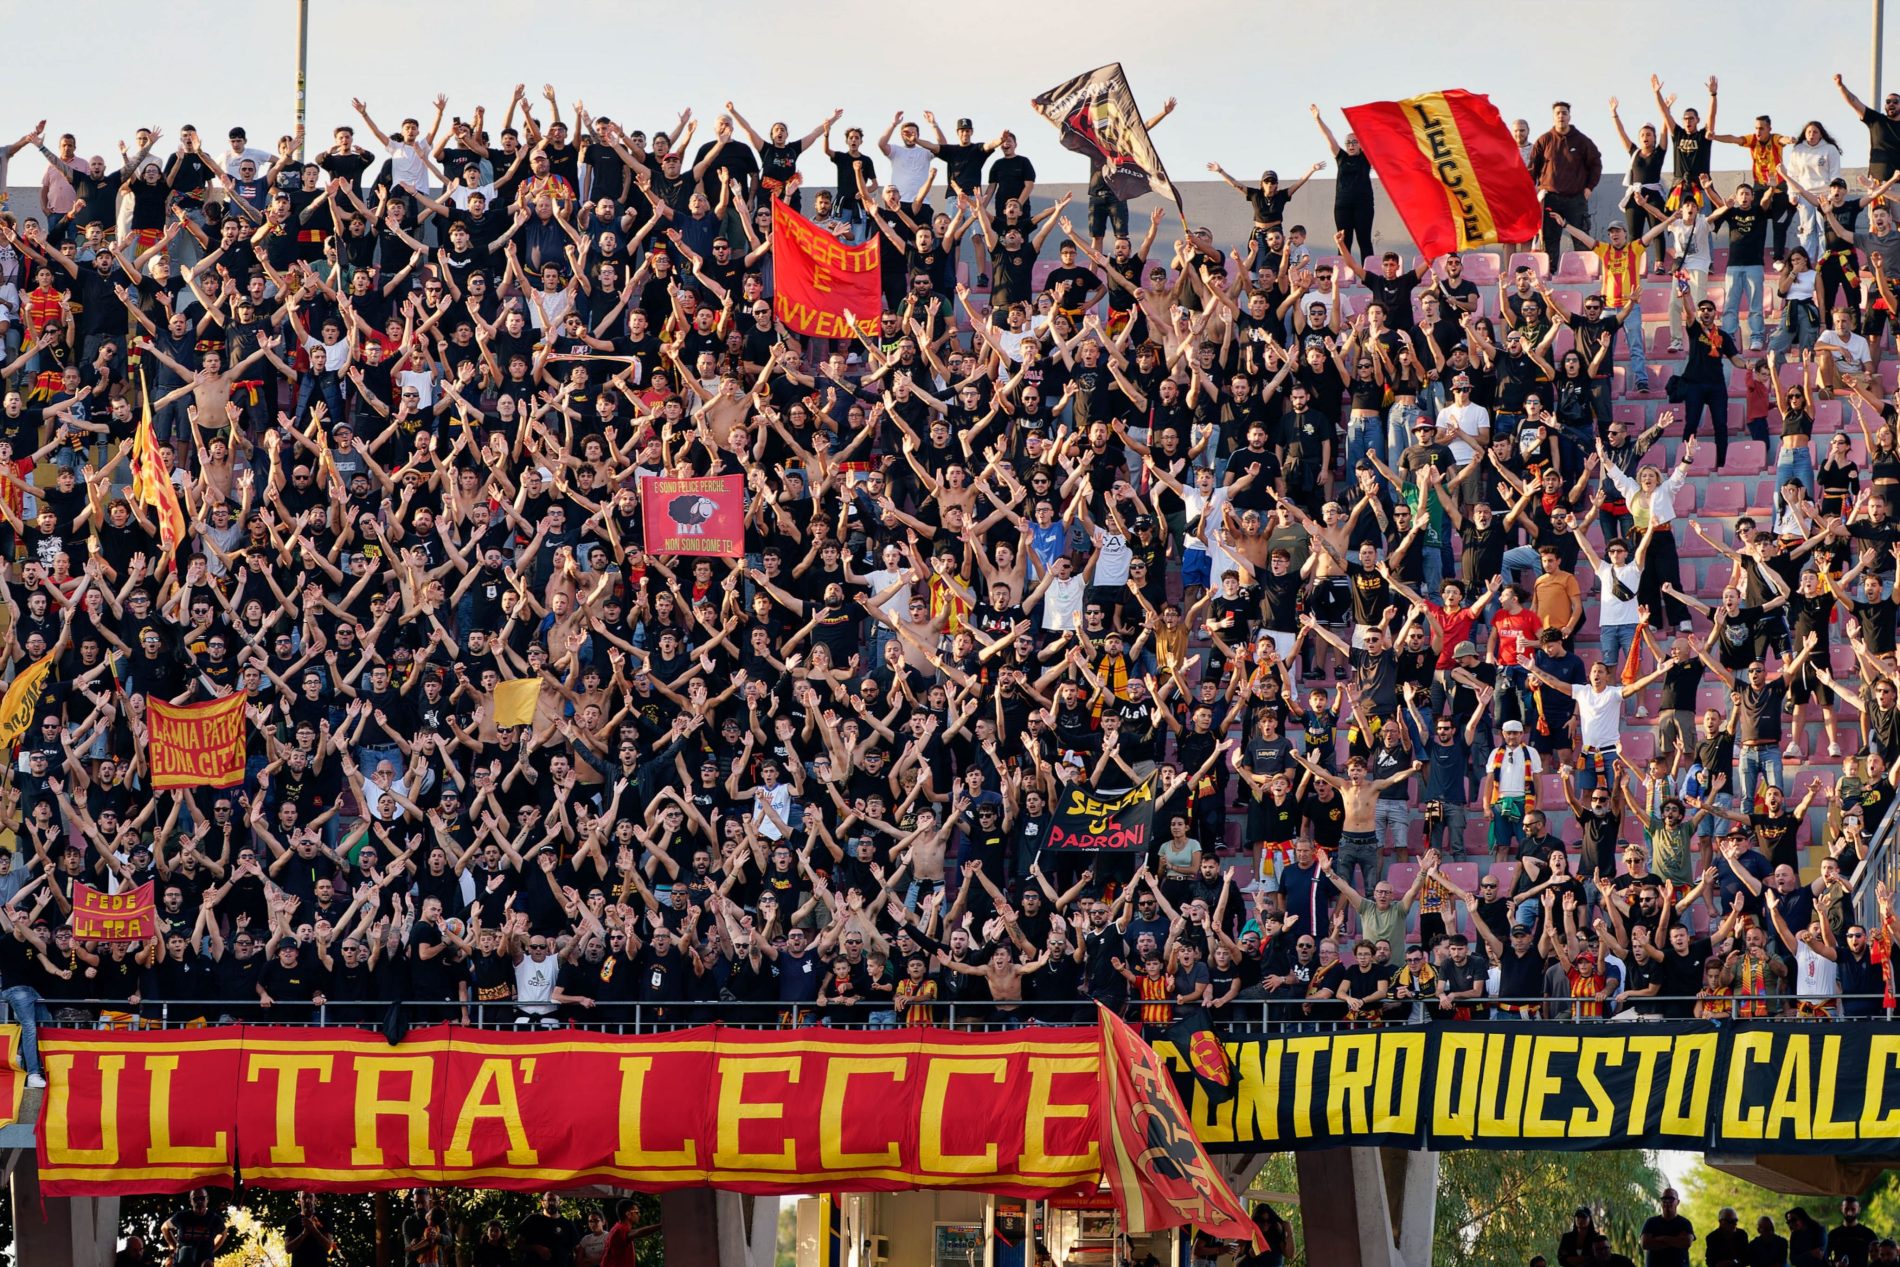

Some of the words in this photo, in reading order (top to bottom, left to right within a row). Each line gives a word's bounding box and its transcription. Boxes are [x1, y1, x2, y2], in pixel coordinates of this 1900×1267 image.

[1413, 104, 1484, 242] LECCE
[776, 206, 879, 273] PASSATO
[813, 265, 831, 293] E
[661, 481, 677, 493] SONO
[679, 481, 699, 493] FELICE
[682, 539, 700, 552] SONO
[702, 539, 721, 553] COME
[1066, 781, 1152, 816] SENZA
[1047, 823, 1144, 849] PADRONI
[85, 892, 136, 910] FEDE
[1433, 1032, 1718, 1141] QUESTO
[1722, 1031, 1900, 1140] CALC
[46, 1054, 537, 1166] ULTRA'
[615, 1057, 1099, 1173] LECCE
